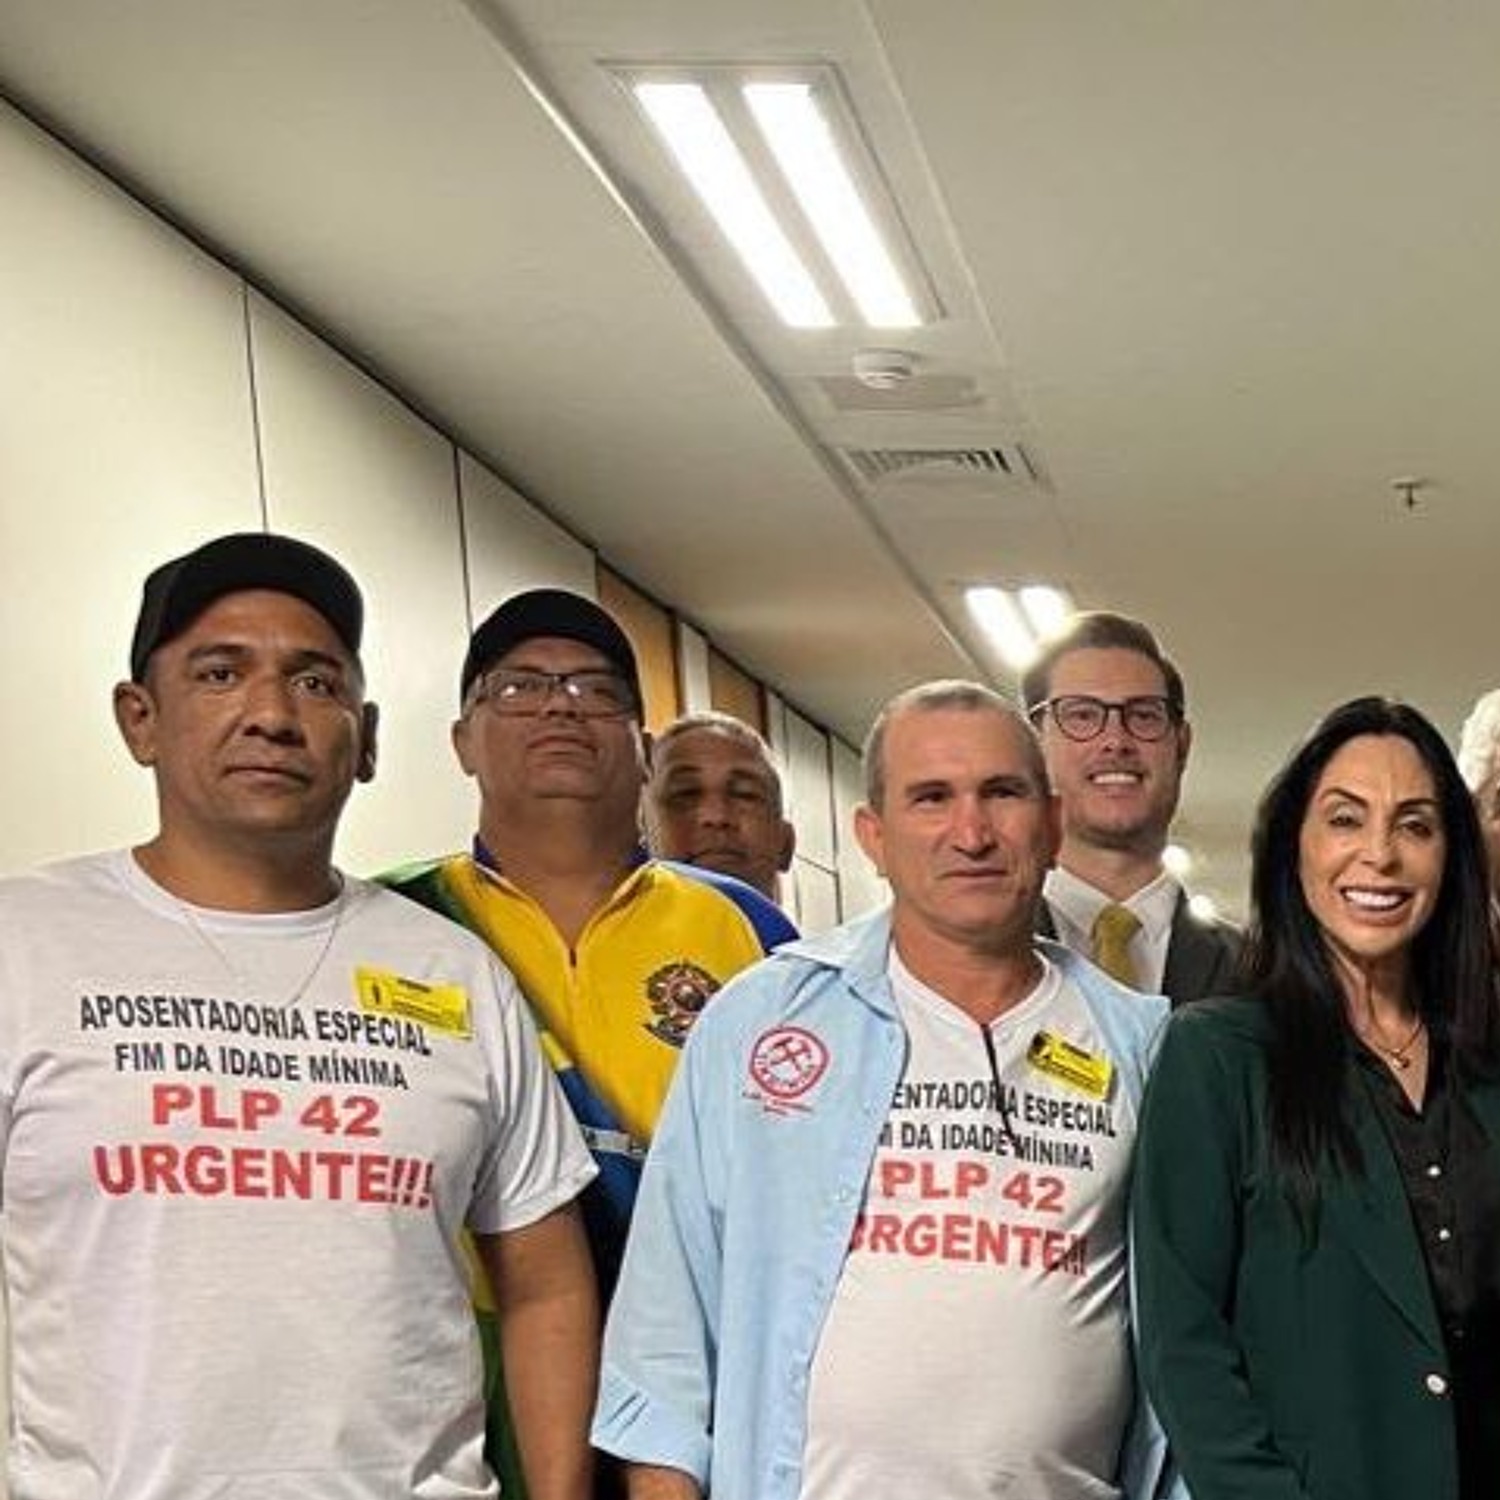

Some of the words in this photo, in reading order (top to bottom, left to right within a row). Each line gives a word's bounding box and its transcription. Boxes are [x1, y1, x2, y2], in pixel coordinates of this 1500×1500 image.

[80, 995, 308, 1041] APOSENTADORIA
[316, 1010, 431, 1056] ESPECIAL
[115, 1042, 164, 1072] FIM
[175, 1042, 211, 1073] DA
[221, 1046, 300, 1081] IDADE
[309, 1050, 409, 1090] MÍNIMA
[152, 1083, 281, 1132] PLP
[299, 1095, 381, 1138] 42
[1025, 1093, 1116, 1138] ESPECIAL
[901, 1123, 933, 1150] DA
[942, 1123, 1008, 1156] IDADE
[94, 1145, 434, 1209] URGENTE!!!
[880, 1160, 989, 1200] PLP
[1002, 1171, 1066, 1213] 42
